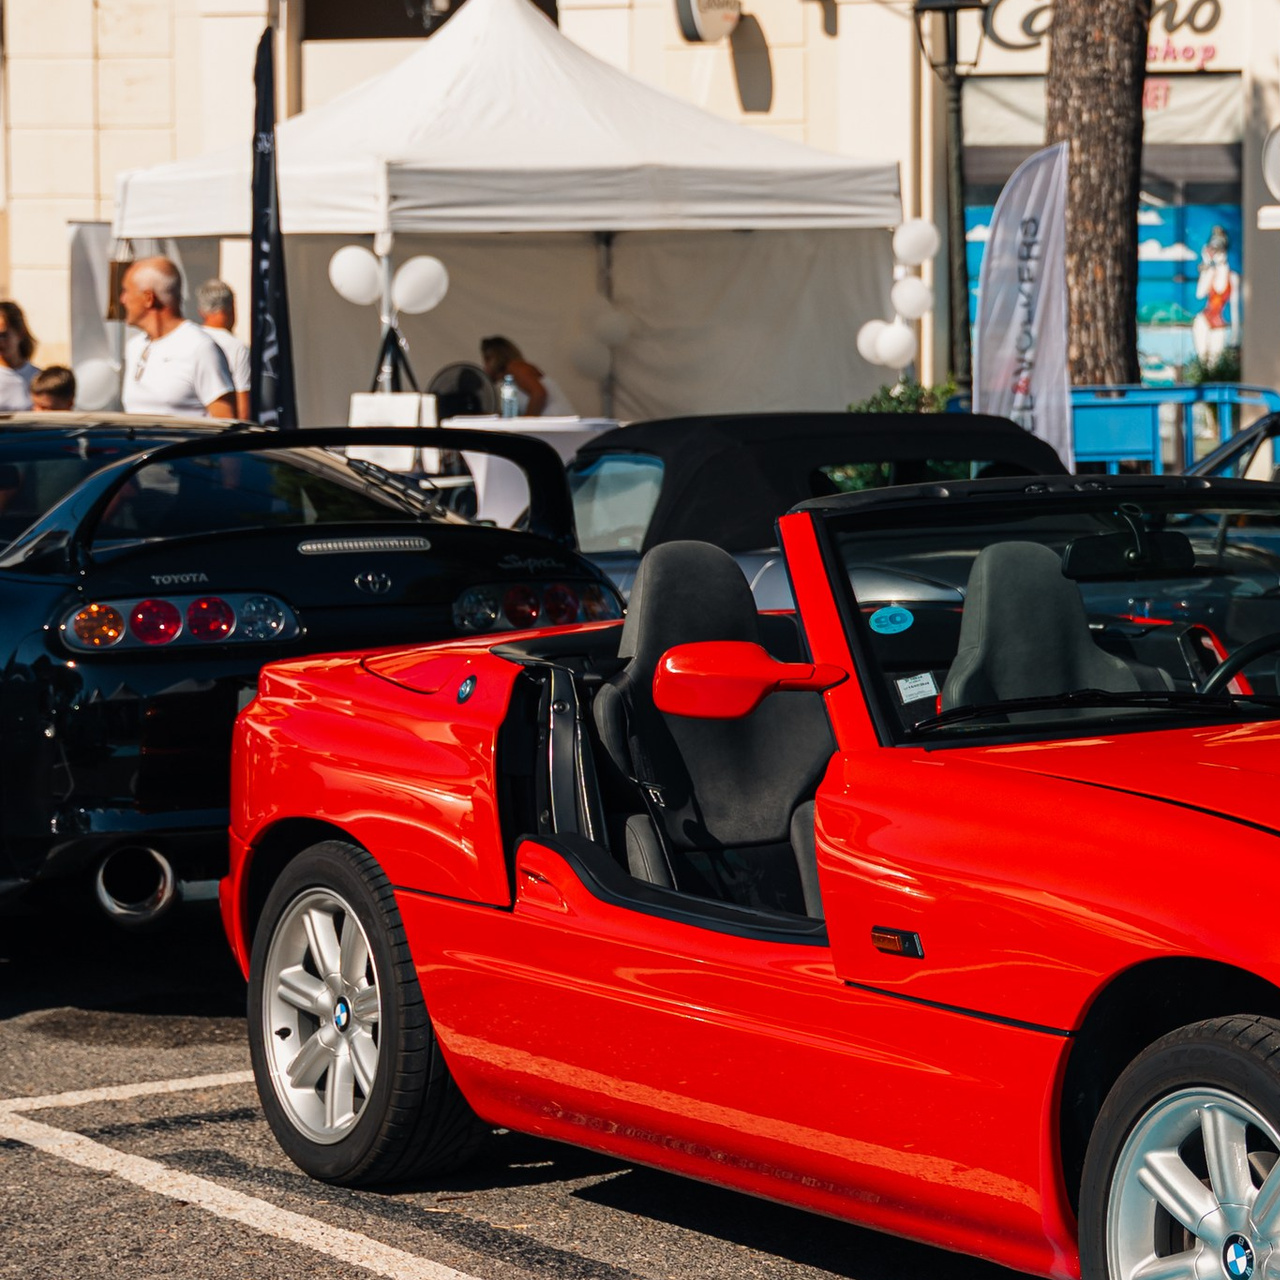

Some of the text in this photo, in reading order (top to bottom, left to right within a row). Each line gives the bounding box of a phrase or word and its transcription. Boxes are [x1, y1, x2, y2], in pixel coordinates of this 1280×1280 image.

[1147, 38, 1216, 70] shop
[497, 554, 566, 575] Supra
[152, 573, 209, 585] TOYOTA
[874, 612, 909, 629] 90
